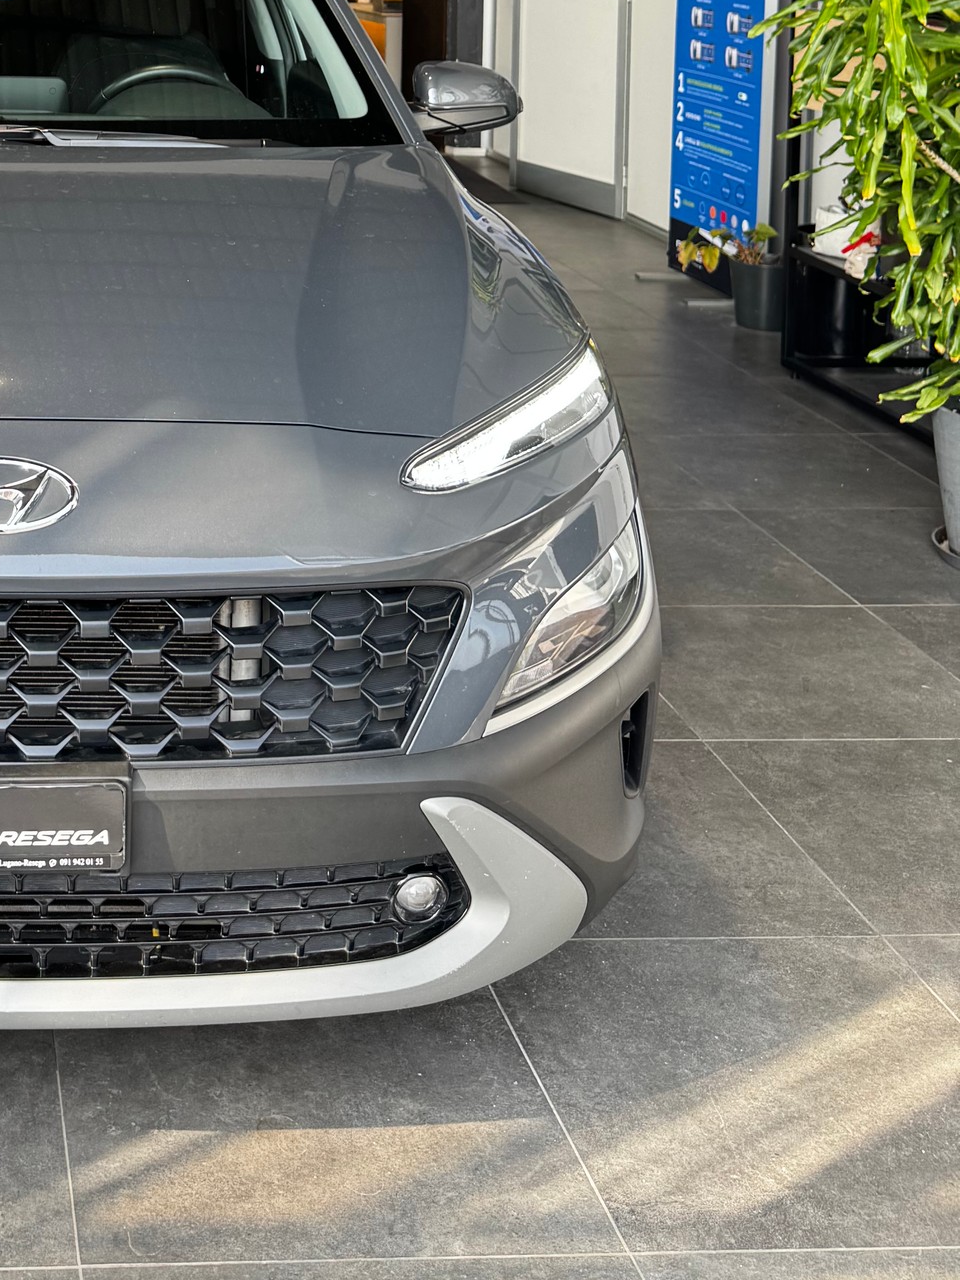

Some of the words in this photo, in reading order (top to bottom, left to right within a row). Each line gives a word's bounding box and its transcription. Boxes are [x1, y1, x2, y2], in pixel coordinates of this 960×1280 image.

[677, 72, 685, 93] 1
[676, 101, 685, 122] 2
[675, 130, 684, 151] 4
[673, 188, 681, 209] 5
[59, 858, 71, 866] 091
[73, 858, 85, 866] 942
[85, 858, 94, 866] 01
[95, 858, 104, 866] 55
